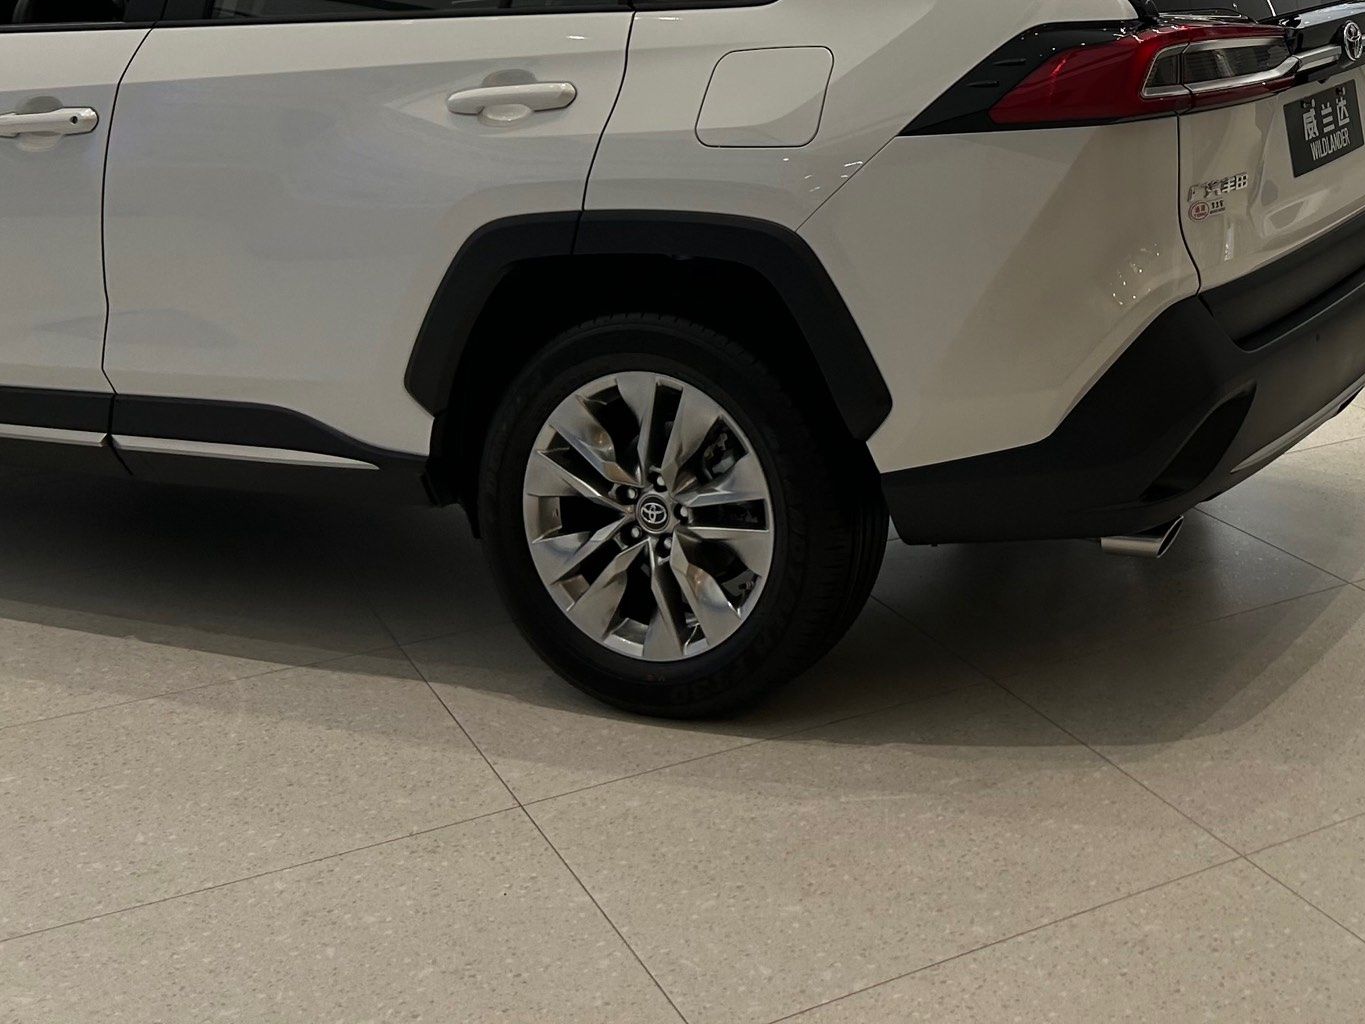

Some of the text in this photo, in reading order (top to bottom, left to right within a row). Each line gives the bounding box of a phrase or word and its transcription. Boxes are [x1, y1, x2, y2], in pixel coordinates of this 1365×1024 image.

[1303, 96, 1350, 141] 威兰达
[1310, 127, 1351, 161] WILDLANDER
